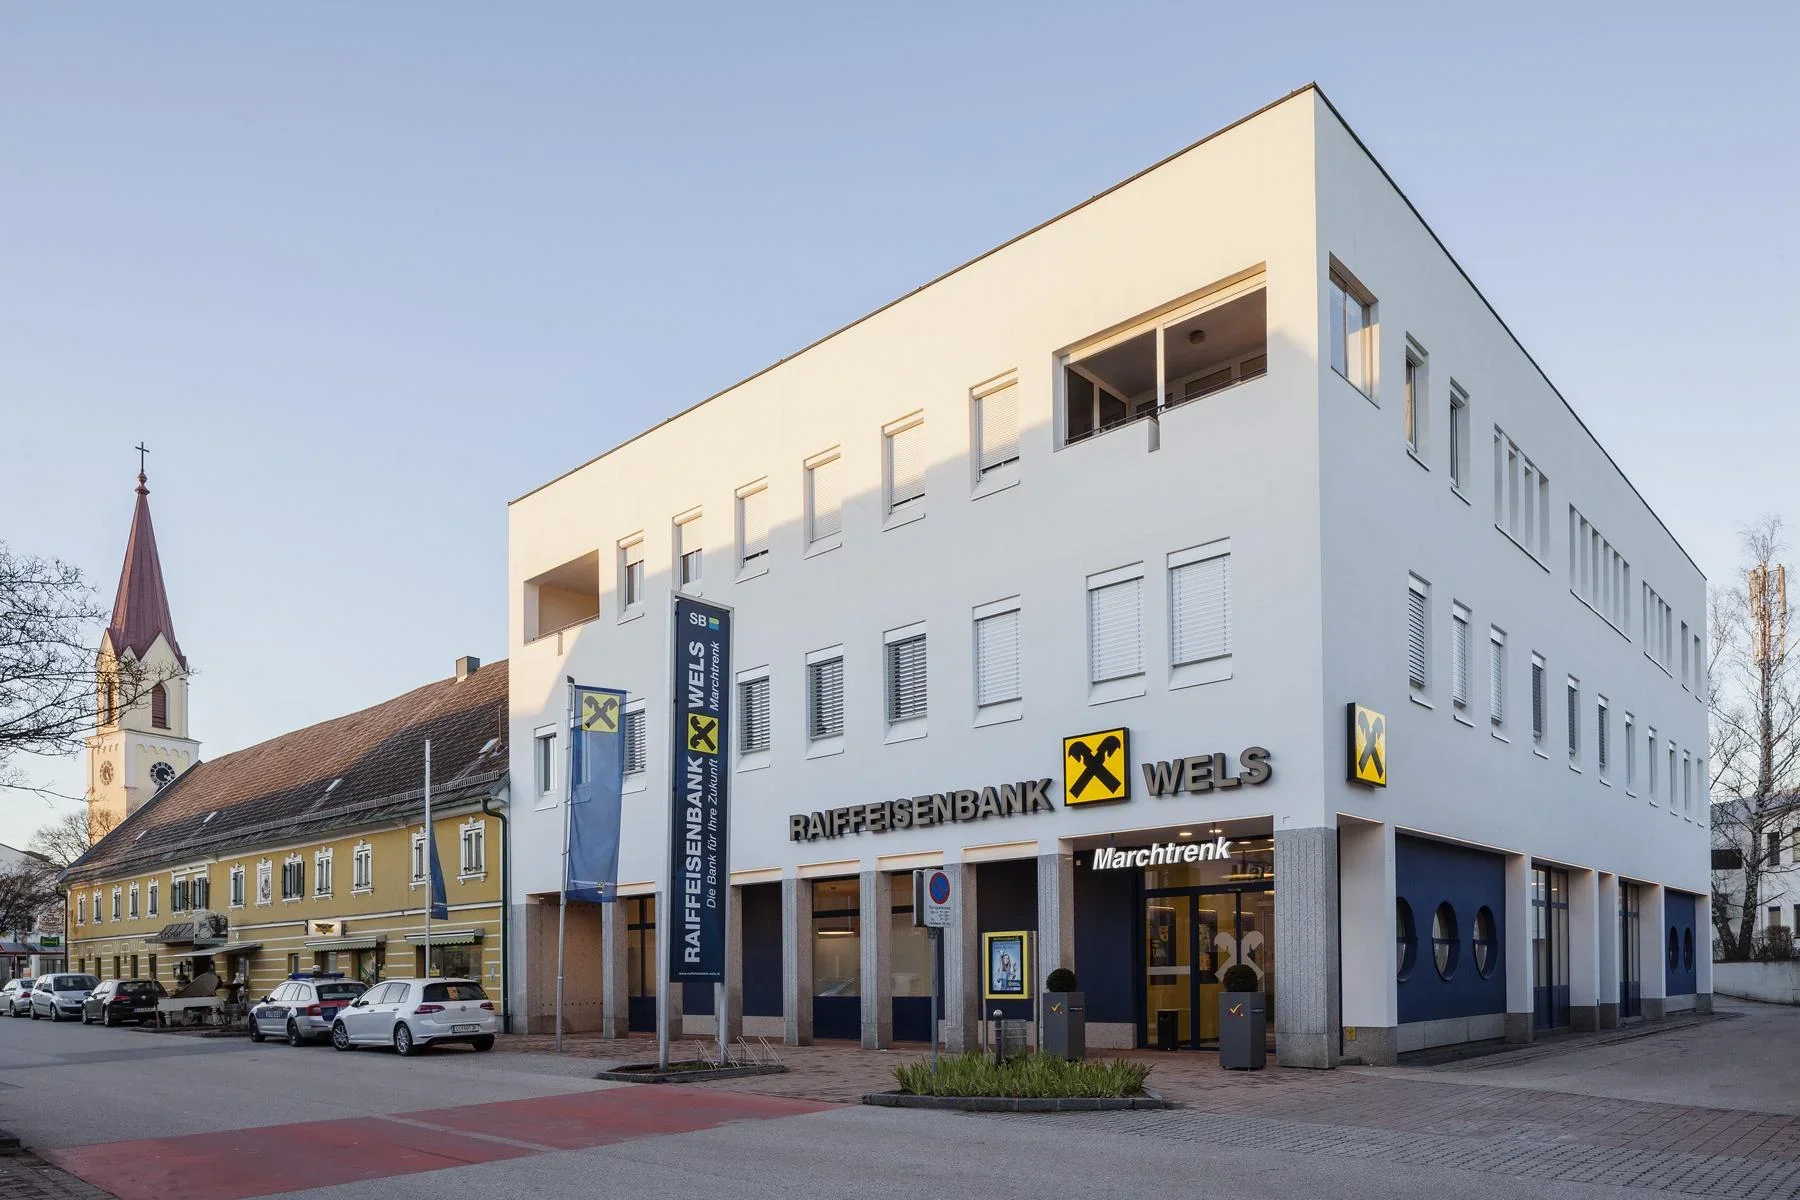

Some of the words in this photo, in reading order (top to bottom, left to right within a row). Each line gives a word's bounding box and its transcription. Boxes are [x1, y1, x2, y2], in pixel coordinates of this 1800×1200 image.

[689, 612, 708, 627] SB
[688, 640, 705, 710] WELS
[710, 641, 721, 712] Marchtrenk
[707, 758, 719, 806] Zukunft
[790, 778, 1054, 842] RAIFFEISENBANK
[1141, 746, 1273, 797] WELS
[707, 807, 718, 832] Ihre
[707, 833, 717, 852] für
[1092, 837, 1232, 870] Marchtrenk
[684, 756, 703, 964] RAIFFEISENBANK
[706, 854, 717, 885] Bank
[706, 888, 717, 909] Die
